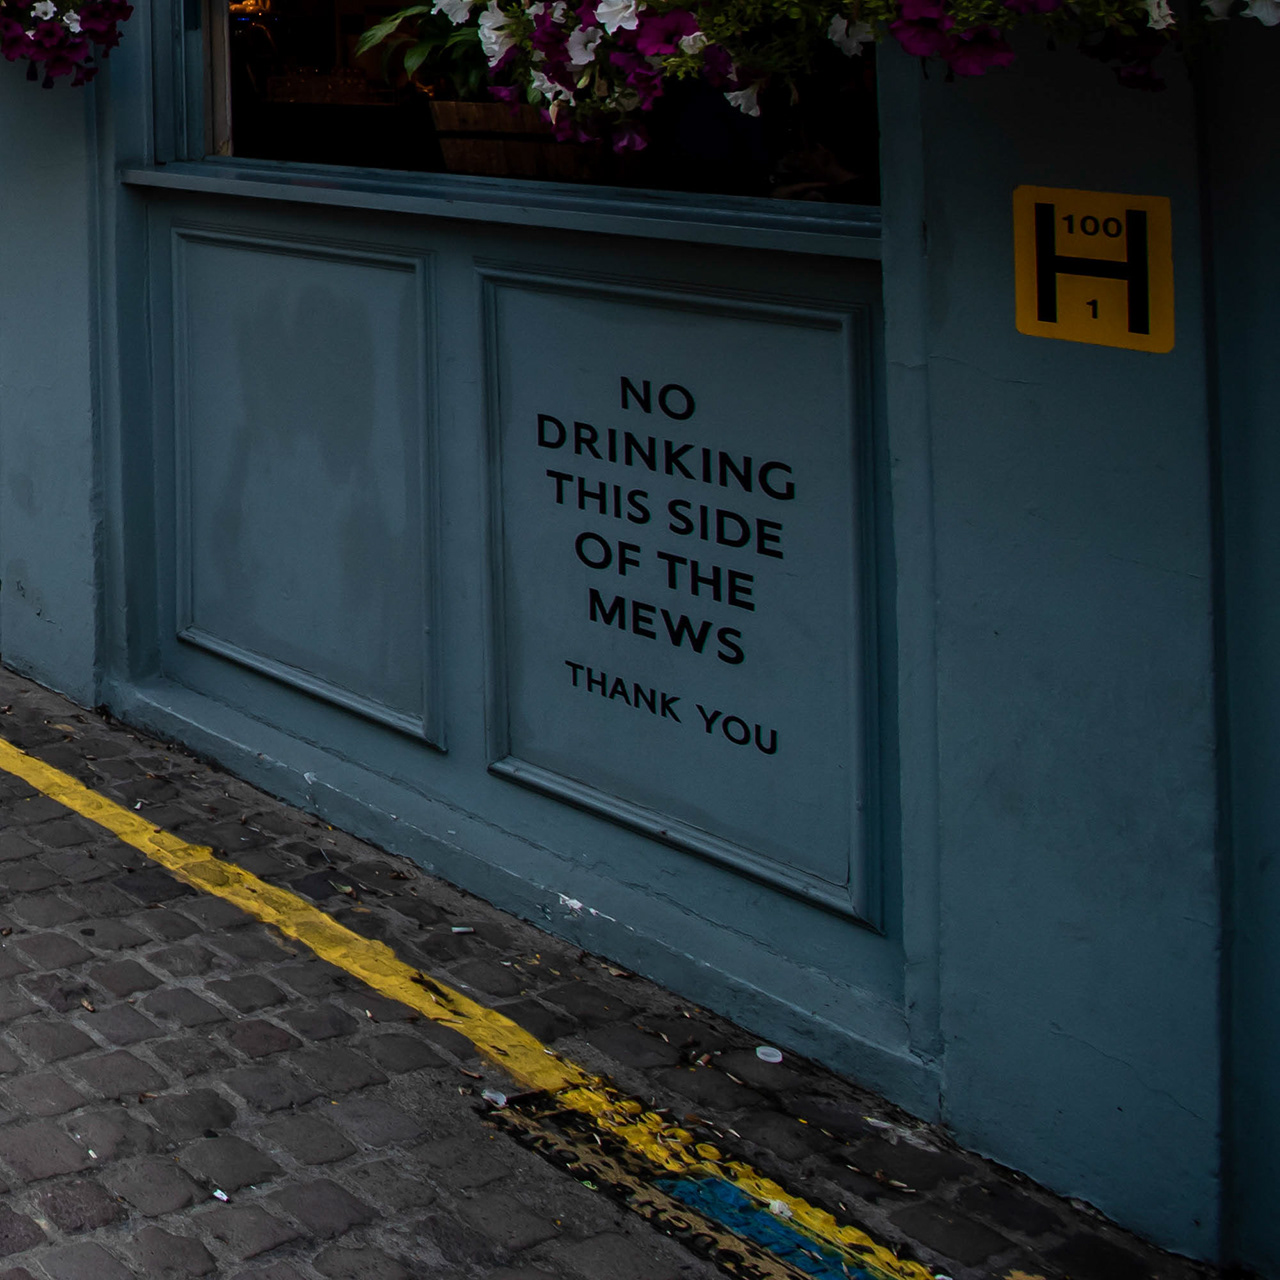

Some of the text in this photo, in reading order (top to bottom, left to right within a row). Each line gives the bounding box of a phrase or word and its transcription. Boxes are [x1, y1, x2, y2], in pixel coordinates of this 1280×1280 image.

[1061, 213, 1123, 239] 100
[1034, 202, 1150, 334] H
[1086, 299, 1099, 319] 1
[619, 376, 696, 421] NO
[536, 414, 796, 500] DRINKING
[546, 470, 784, 559] THIS SIDE
[575, 531, 756, 611] OF THE
[588, 590, 745, 665] MEWS
[565, 661, 778, 755] THANK YOU
